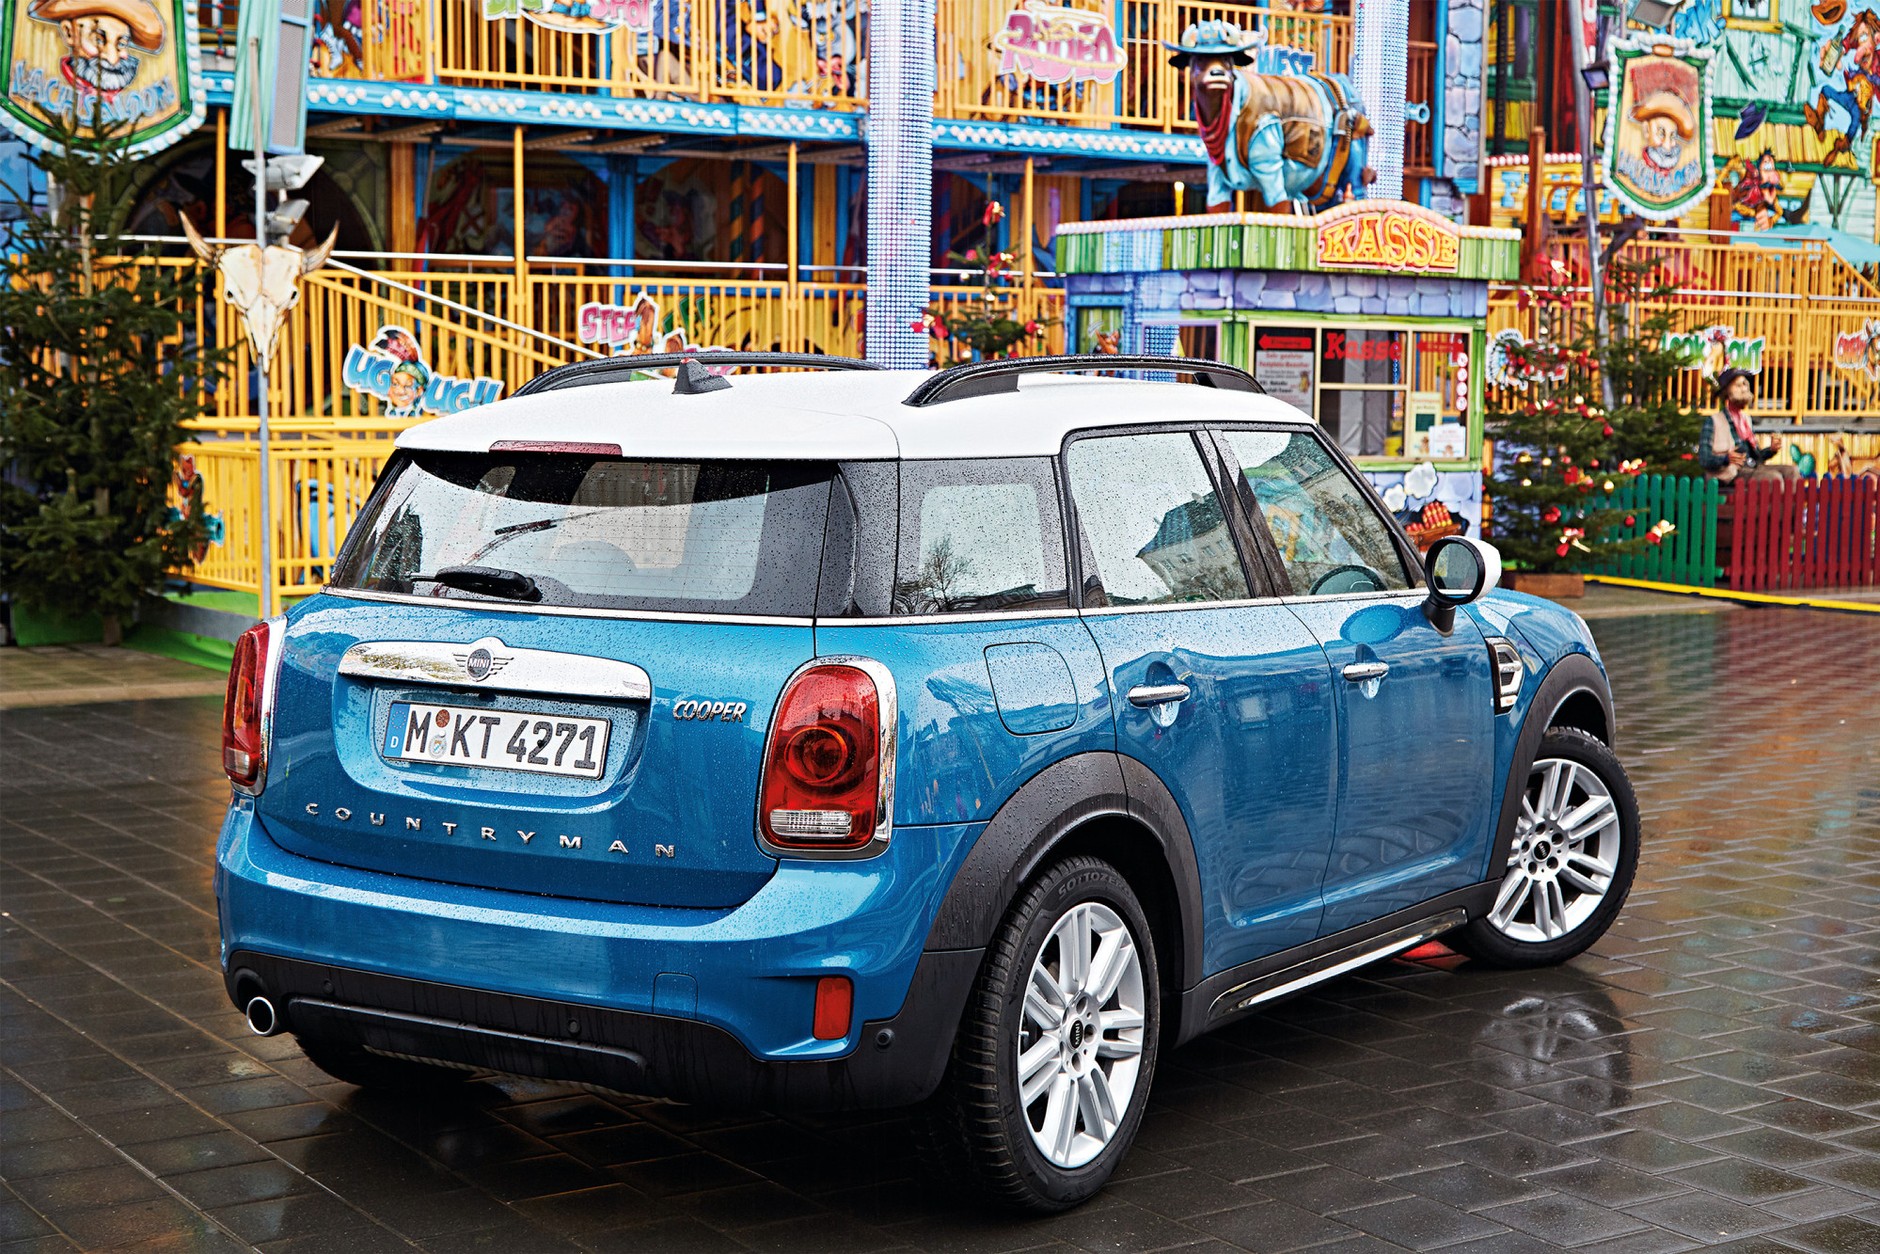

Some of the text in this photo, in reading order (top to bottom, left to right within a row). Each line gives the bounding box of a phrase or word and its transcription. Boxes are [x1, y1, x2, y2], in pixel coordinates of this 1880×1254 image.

[1002, 14, 1116, 81] RODEO
[1257, 47, 1313, 75] WEST
[1321, 214, 1458, 268] KASSE
[1324, 332, 1403, 361] Kasse
[1727, 339, 1763, 372] OUT
[347, 348, 394, 396] UG
[468, 657, 490, 669] MINI
[672, 699, 748, 723] COOPER
[390, 736, 399, 749] D
[405, 710, 597, 771] M KT 4271
[304, 802, 675, 859] COUNTRYMAN
